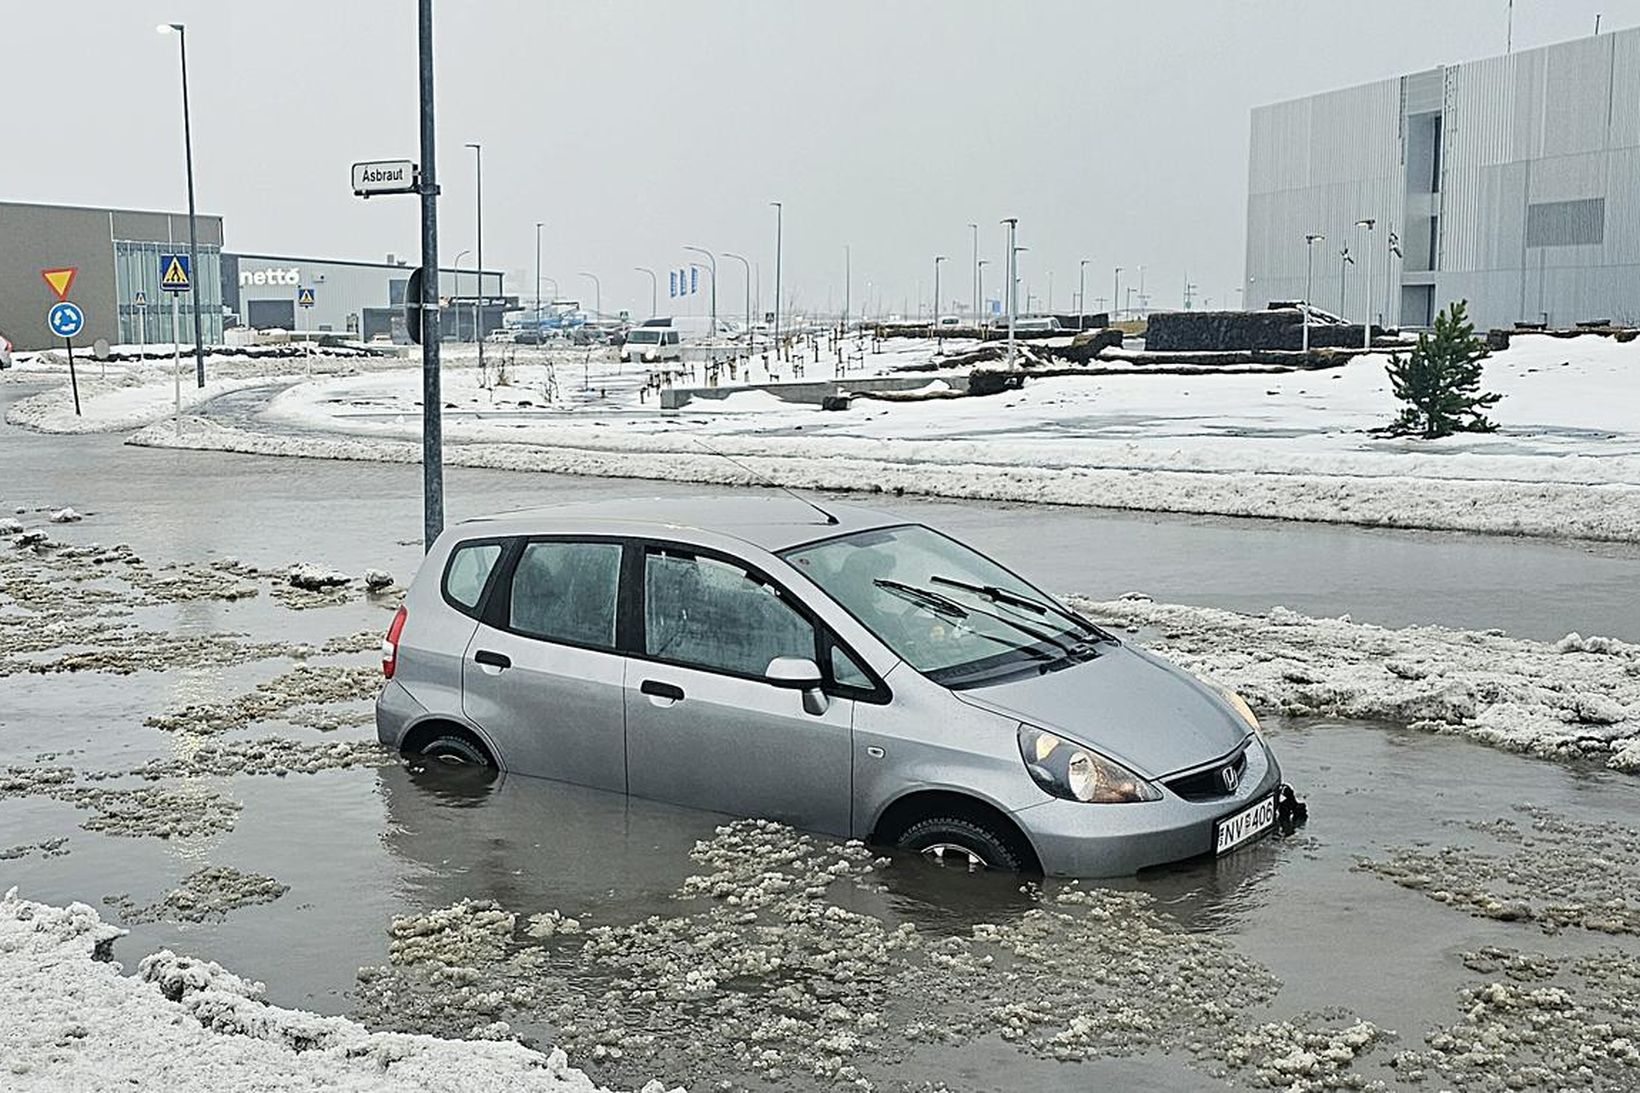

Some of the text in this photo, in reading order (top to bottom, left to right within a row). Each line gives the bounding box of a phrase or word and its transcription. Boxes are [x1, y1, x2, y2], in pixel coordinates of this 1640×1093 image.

[362, 165, 403, 182] Ásbraut
[240, 268, 299, 285] nettó
[1225, 816, 1244, 846] NV
[1252, 801, 1273, 829] 406
